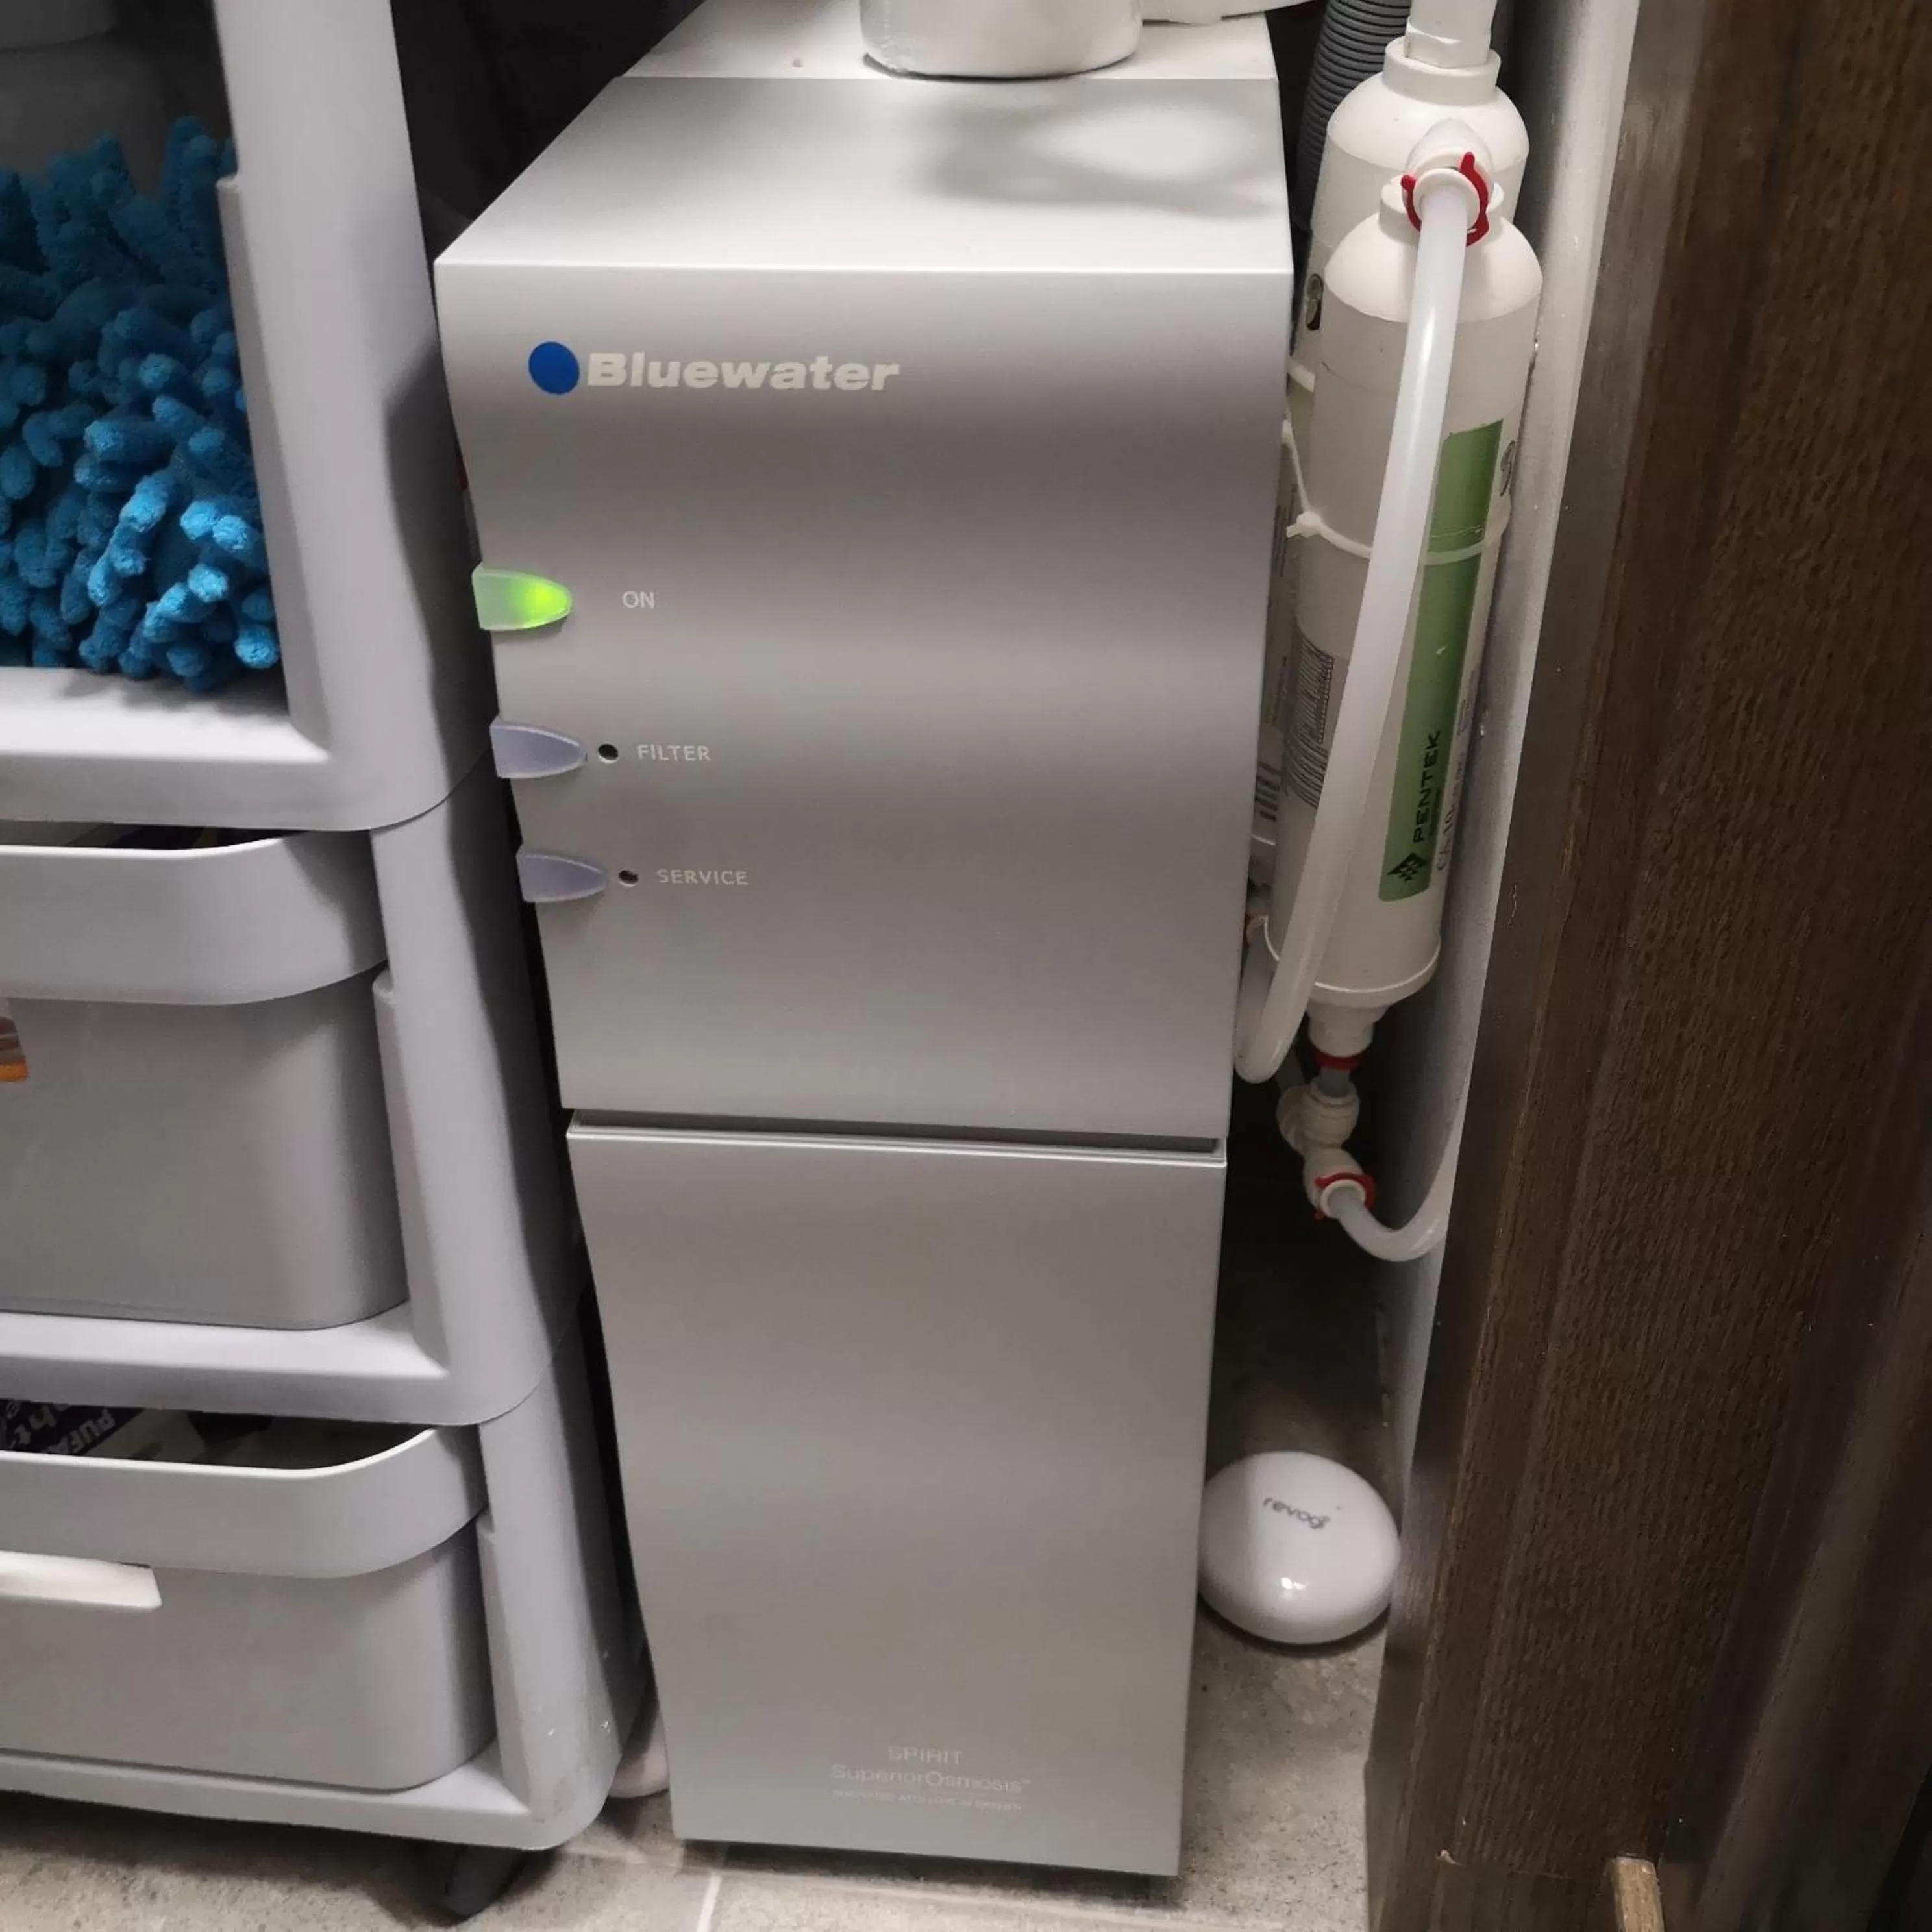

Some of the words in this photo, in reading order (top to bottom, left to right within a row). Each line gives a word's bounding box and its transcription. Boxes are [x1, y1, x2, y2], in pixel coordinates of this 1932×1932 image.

[588, 351, 900, 391] Bluewater
[622, 590, 656, 608] ON
[636, 743, 711, 762] FILTER
[1413, 730, 1441, 843] PENTEK
[656, 868, 749, 886] SERVICE
[888, 1746, 963, 1765] SPIRIT
